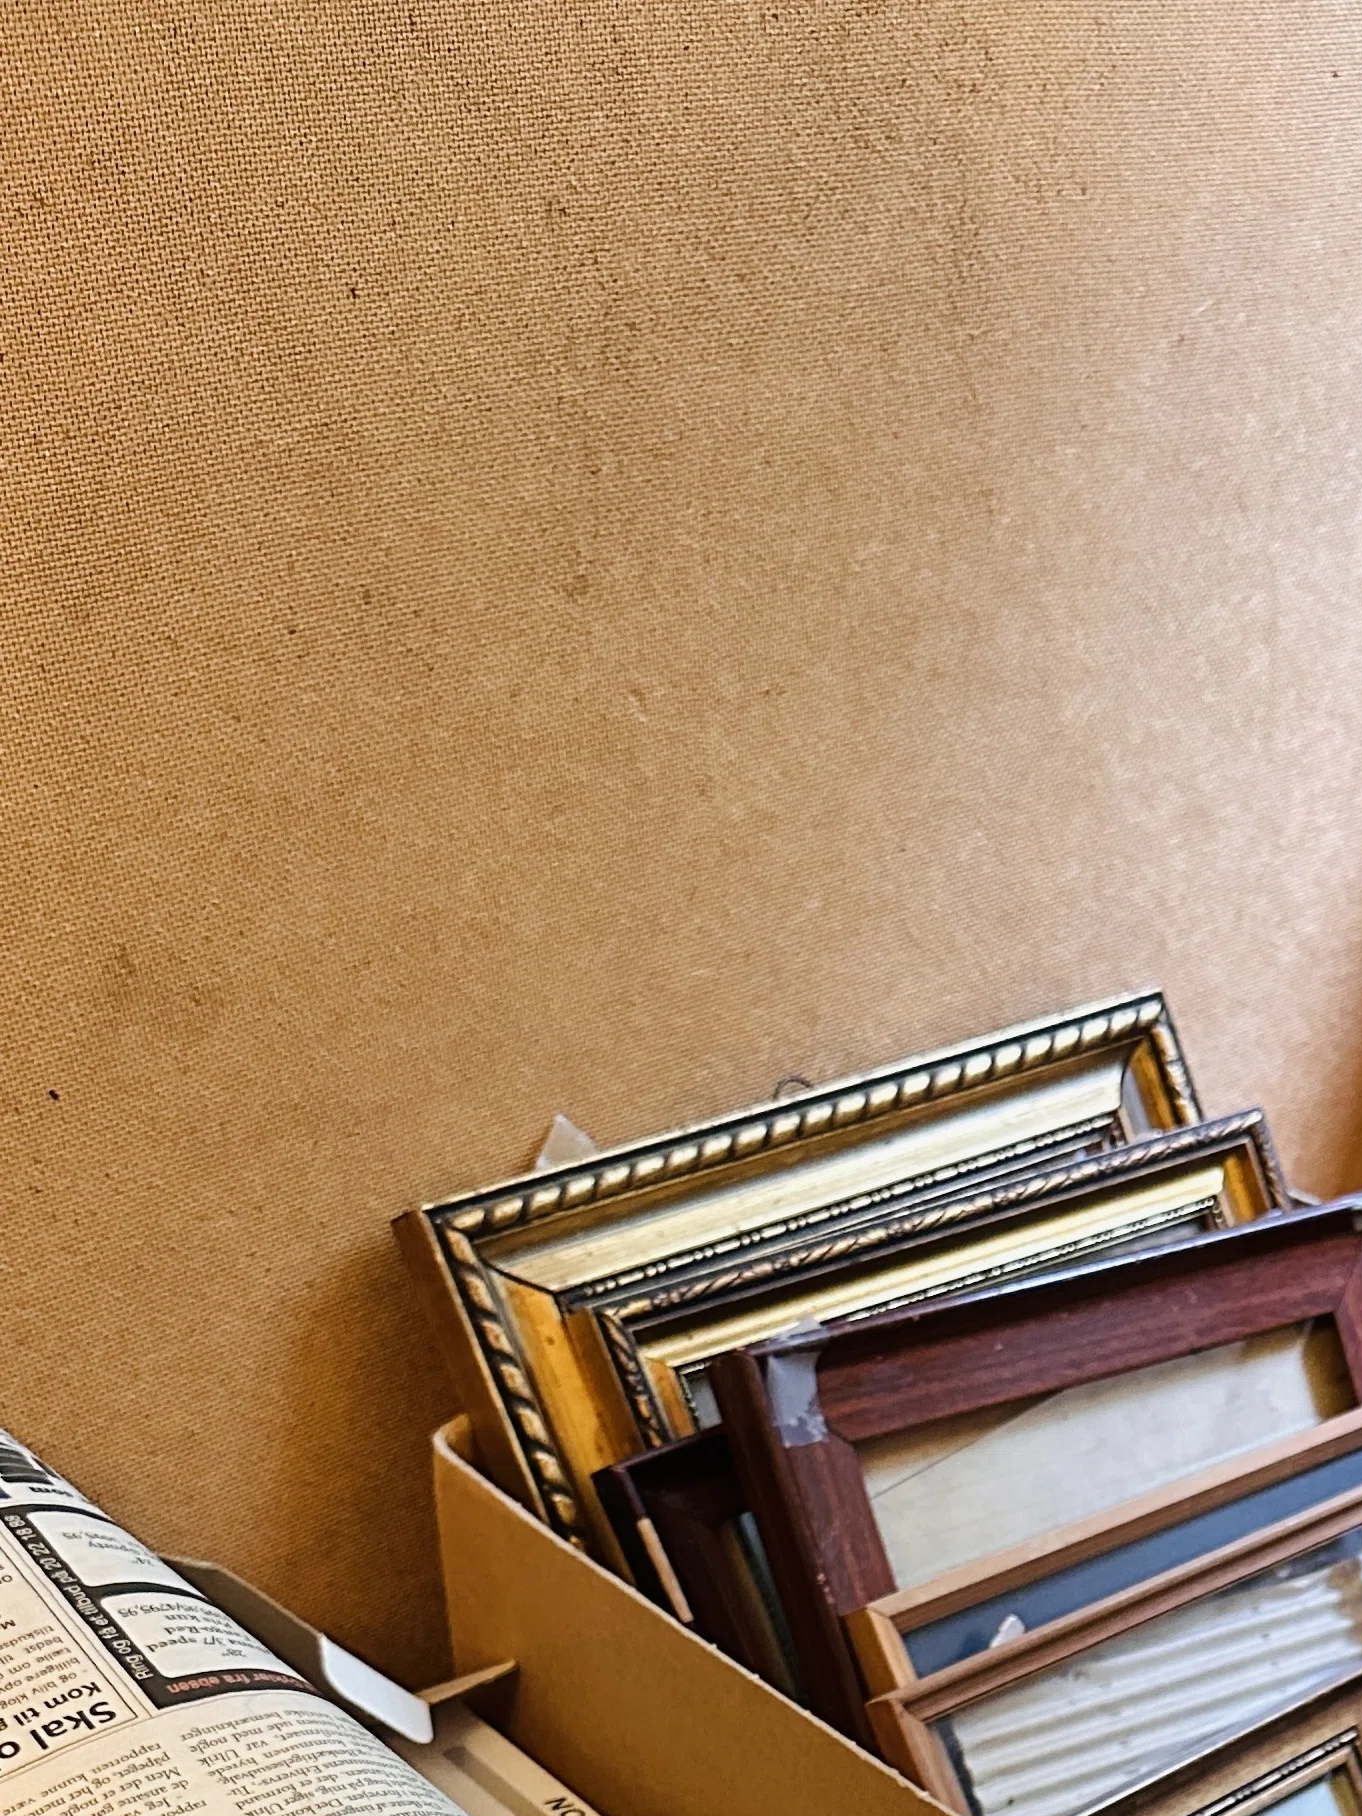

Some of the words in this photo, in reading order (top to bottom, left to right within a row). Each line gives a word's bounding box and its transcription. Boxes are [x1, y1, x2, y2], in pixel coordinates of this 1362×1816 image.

[17, 1526, 36, 1541] 18
[28, 1539, 50, 1558] 22
[41, 1554, 61, 1571] 20
[53, 1569, 78, 1585] på
[65, 1583, 98, 1617] tilbud
[88, 1613, 109, 1627] et
[101, 1626, 119, 1641] få
[113, 1637, 132, 1654] og
[126, 1650, 154, 1680] Ring
[43, 1681, 102, 1710] Kom
[12, 1707, 37, 1726] til
[28, 1701, 116, 1750] Skal
